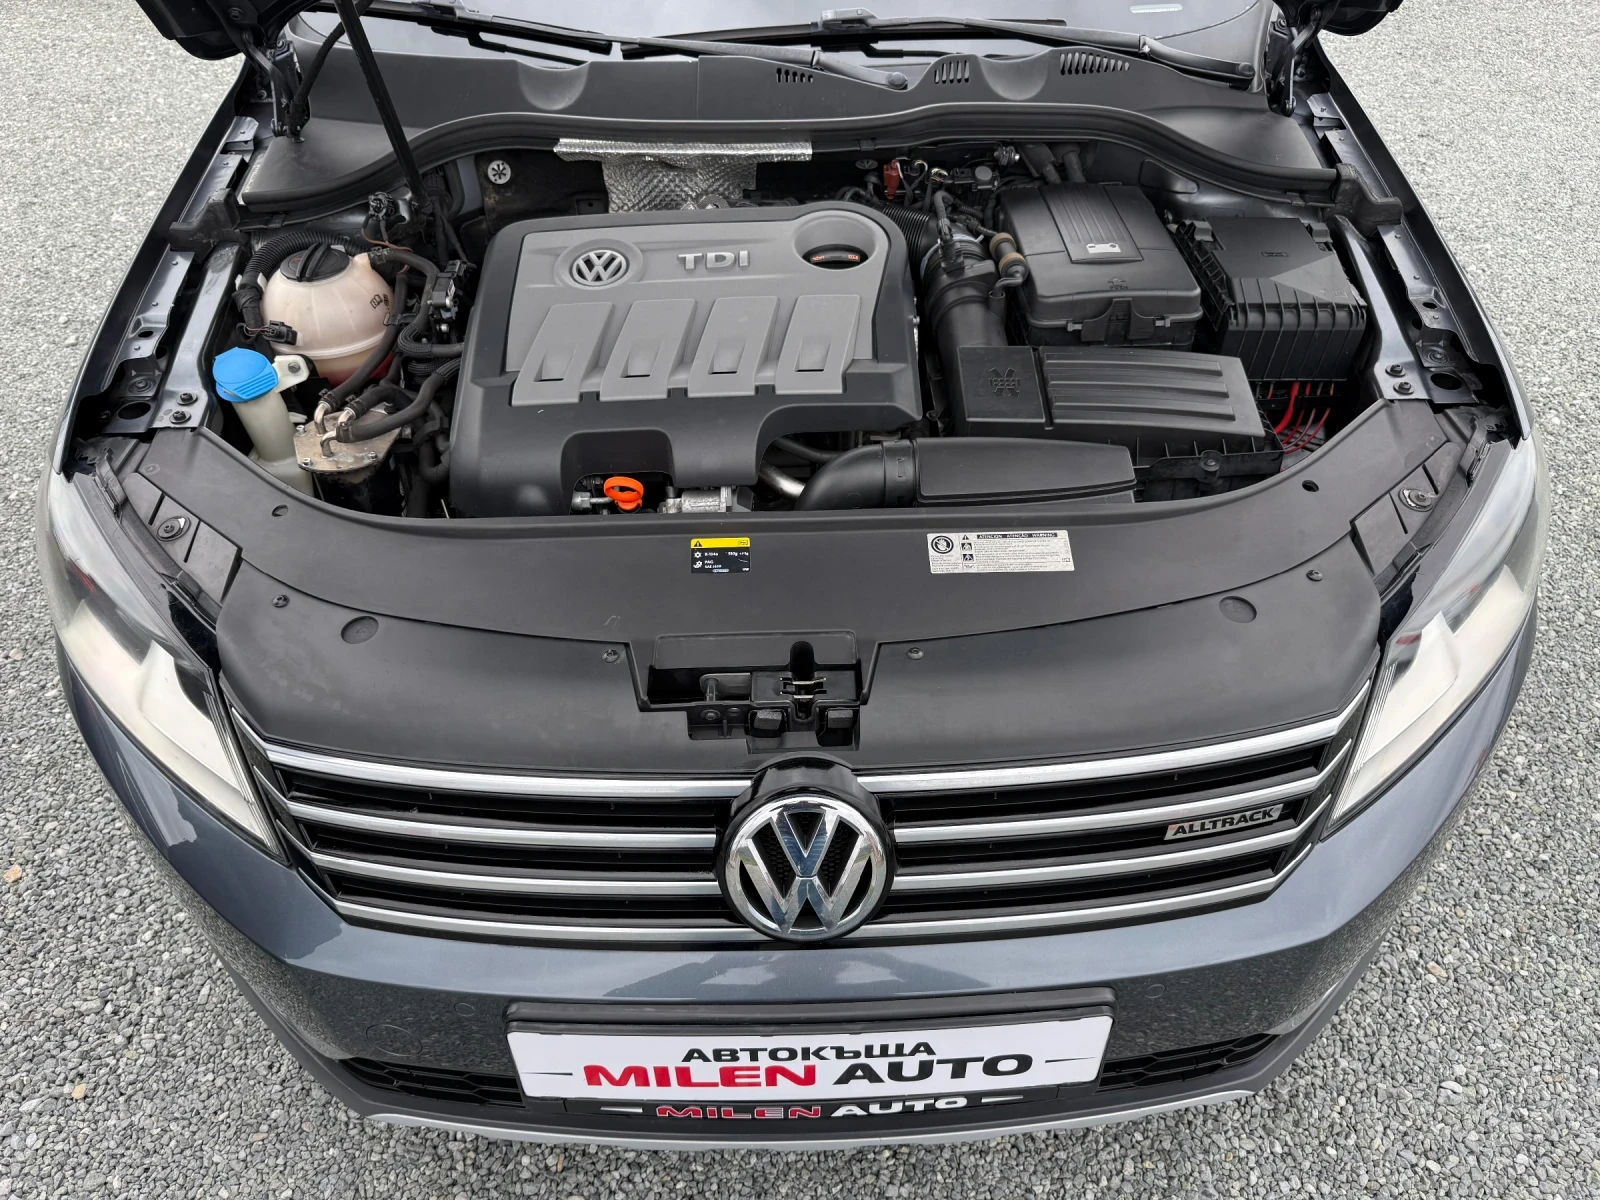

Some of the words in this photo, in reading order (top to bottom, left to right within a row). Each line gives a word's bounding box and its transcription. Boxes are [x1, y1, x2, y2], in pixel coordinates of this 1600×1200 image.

[573, 249, 628, 285] VW
[677, 250, 749, 270] TDI
[1171, 807, 1274, 836] ALLTRACK
[725, 794, 887, 941] VW
[681, 1041, 936, 1062] АВТОКЪЩА
[583, 1064, 817, 1087] MILEN
[832, 1054, 1033, 1085] AUTO
[656, 1105, 821, 1119] MILEN
[830, 1097, 968, 1117] AUTO
